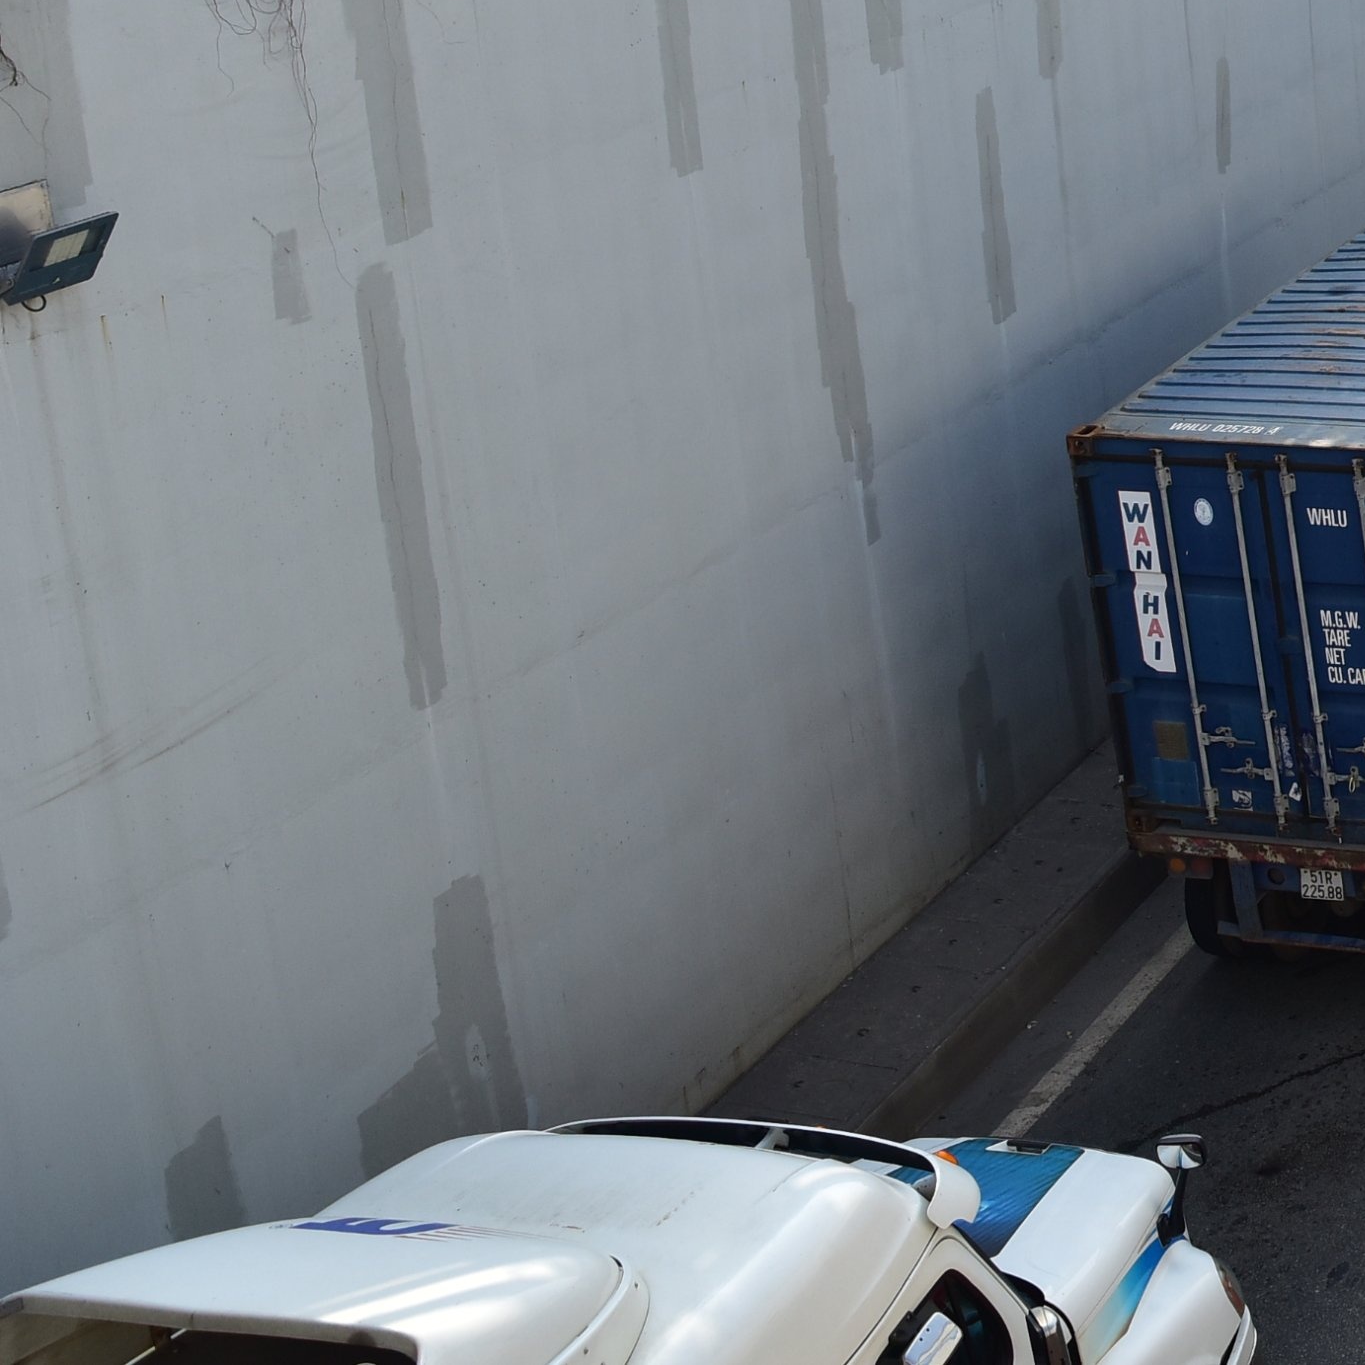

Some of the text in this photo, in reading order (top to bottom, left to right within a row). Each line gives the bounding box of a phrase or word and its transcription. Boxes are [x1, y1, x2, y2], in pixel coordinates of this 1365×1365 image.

[1169, 422, 1212, 432] WHLU
[1212, 424, 1264, 434] 025728
[1306, 507, 1348, 527] WHLU
[1122, 502, 1165, 661] WAN HAI
[1320, 610, 1361, 629] M.G.W.
[1323, 628, 1351, 647] TARE
[1325, 647, 1346, 665] NET
[1328, 666, 1346, 683] CU.
[1310, 871, 1333, 884] 51R
[1302, 884, 1343, 900] 225.88
